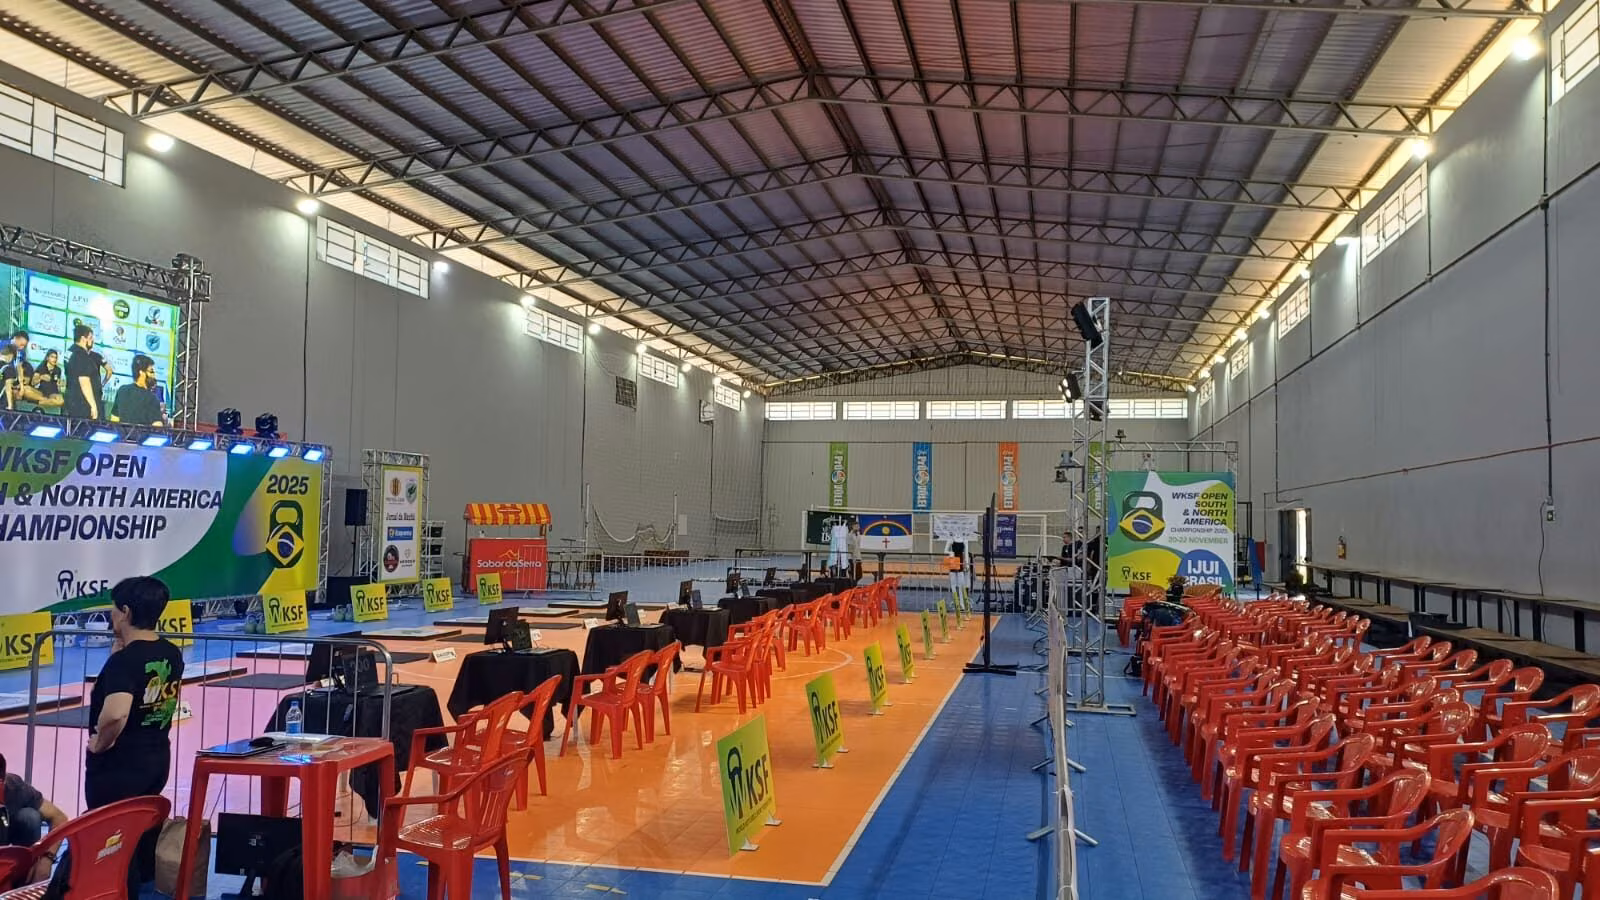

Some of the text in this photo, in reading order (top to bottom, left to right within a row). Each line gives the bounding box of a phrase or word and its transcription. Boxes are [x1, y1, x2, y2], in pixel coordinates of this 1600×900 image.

[76, 452, 147, 478] OPEN
[266, 474, 309, 495] 2025
[14, 482, 33, 506] &
[40, 484, 127, 508] NORTH
[130, 488, 222, 509] AMERICA
[1172, 492, 1228, 500] WKSF OPEN
[1192, 509, 1227, 517] NORTH
[1184, 518, 1226, 526] AMERICA
[1189, 536, 1228, 544] NOVEMBER
[1188, 560, 1219, 575] IJUI
[156, 617, 187, 633] KSF
